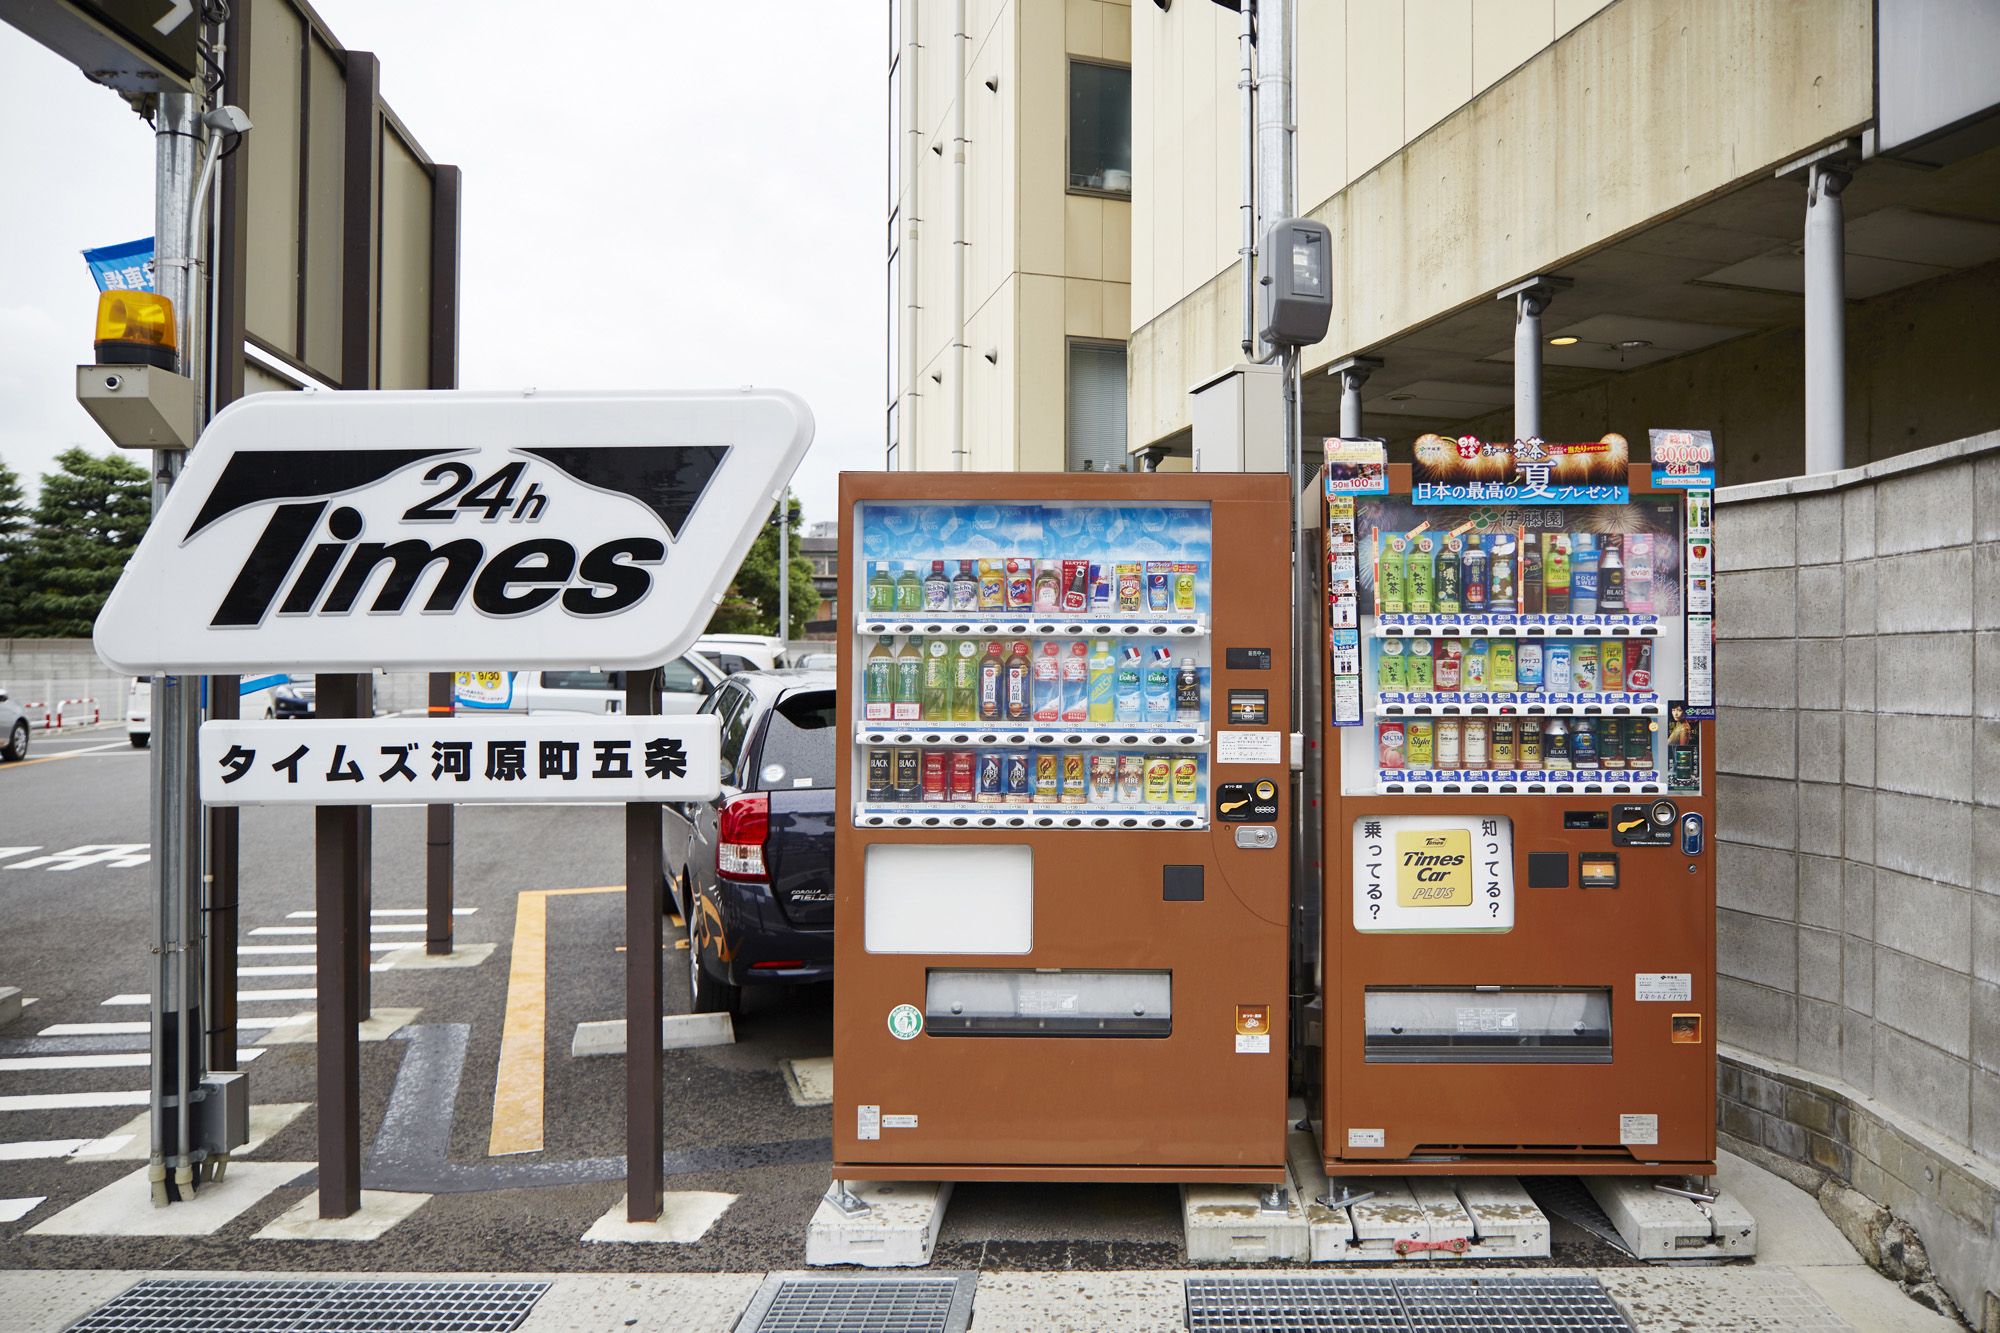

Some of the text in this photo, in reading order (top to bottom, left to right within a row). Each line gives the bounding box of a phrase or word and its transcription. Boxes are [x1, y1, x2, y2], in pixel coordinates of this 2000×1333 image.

[1656, 447, 1710, 462] 30,000
[402, 461, 547, 522] 24h
[1501, 508, 1564, 528] 伊藤園
[205, 495, 667, 629] Times
[1630, 569, 1650, 577] evian
[1582, 661, 1597, 676] 梅
[219, 738, 689, 784] タイムズ河原町五条
[870, 760, 888, 768] BLACK
[899, 760, 916, 768] BLACK
[1404, 851, 1466, 867] Times
[1364, 821, 1383, 920] 乗ってる？
[1416, 867, 1452, 882] Car
[1482, 820, 1501, 918] 知ってる？
[1412, 887, 1455, 899] PLUS
